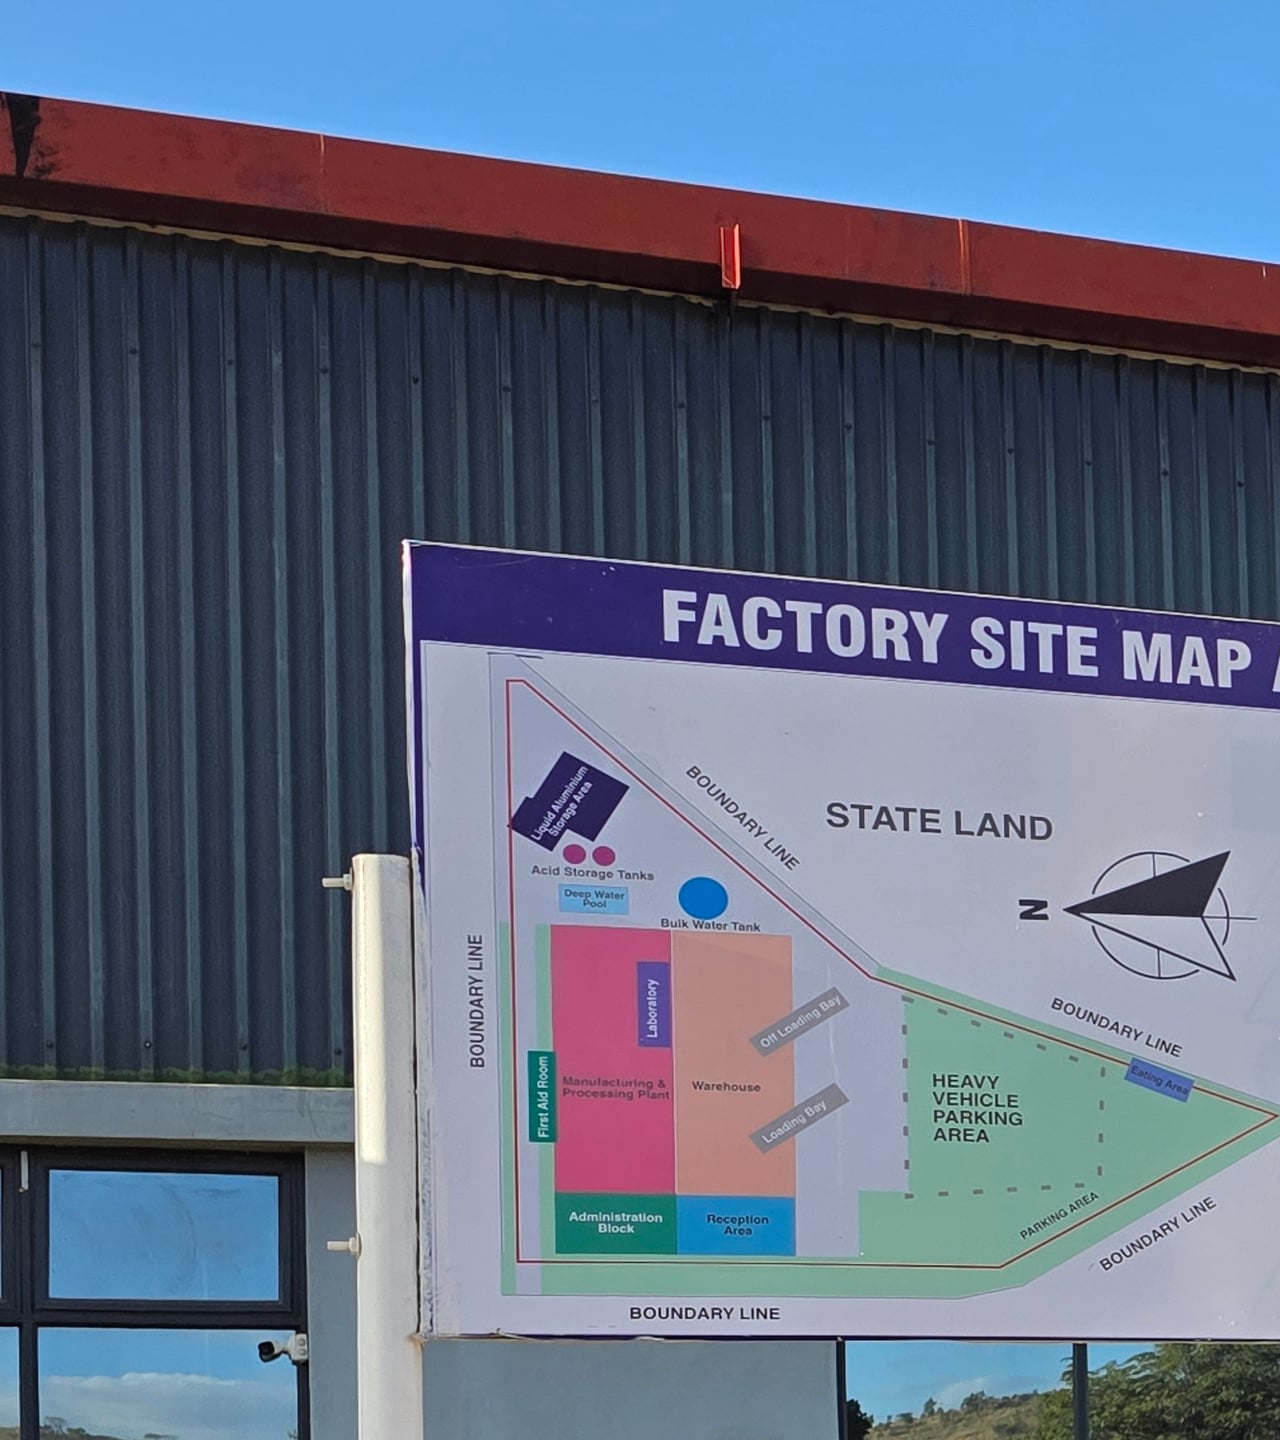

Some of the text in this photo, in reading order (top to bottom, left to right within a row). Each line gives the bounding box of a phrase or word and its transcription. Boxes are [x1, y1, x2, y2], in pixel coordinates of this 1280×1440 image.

[663, 590, 948, 663] FACTORY
[971, 617, 1098, 676] SITE
[1122, 630, 1251, 688] MAP
[686, 766, 801, 871] BOUNDARY LINE
[827, 803, 1052, 840] STATE LAND
[531, 865, 654, 881] Acid Storage Tanks
[1018, 899, 1049, 921] N
[660, 917, 761, 933] Bulk Water Tank
[468, 935, 484, 1067] BOUNDARY LINE
[647, 979, 659, 1038] Laboratory
[1052, 998, 1182, 1057] BOUNDARY LINE
[692, 1080, 761, 1092] Warehouse
[933, 1074, 999, 1089] HEAVY
[933, 1092, 1018, 1108] VEHICLE
[934, 1110, 1022, 1126] PARKING
[934, 1128, 989, 1142] AREA
[569, 1211, 663, 1223] Administration
[706, 1214, 769, 1225] Reception
[1020, 1192, 1098, 1239] PARKING AREA
[598, 1223, 635, 1234] Block
[724, 1226, 752, 1235] Area
[1100, 1197, 1216, 1270] BOUNDARY LINE
[630, 1306, 780, 1320] BOUNDARY LINE
